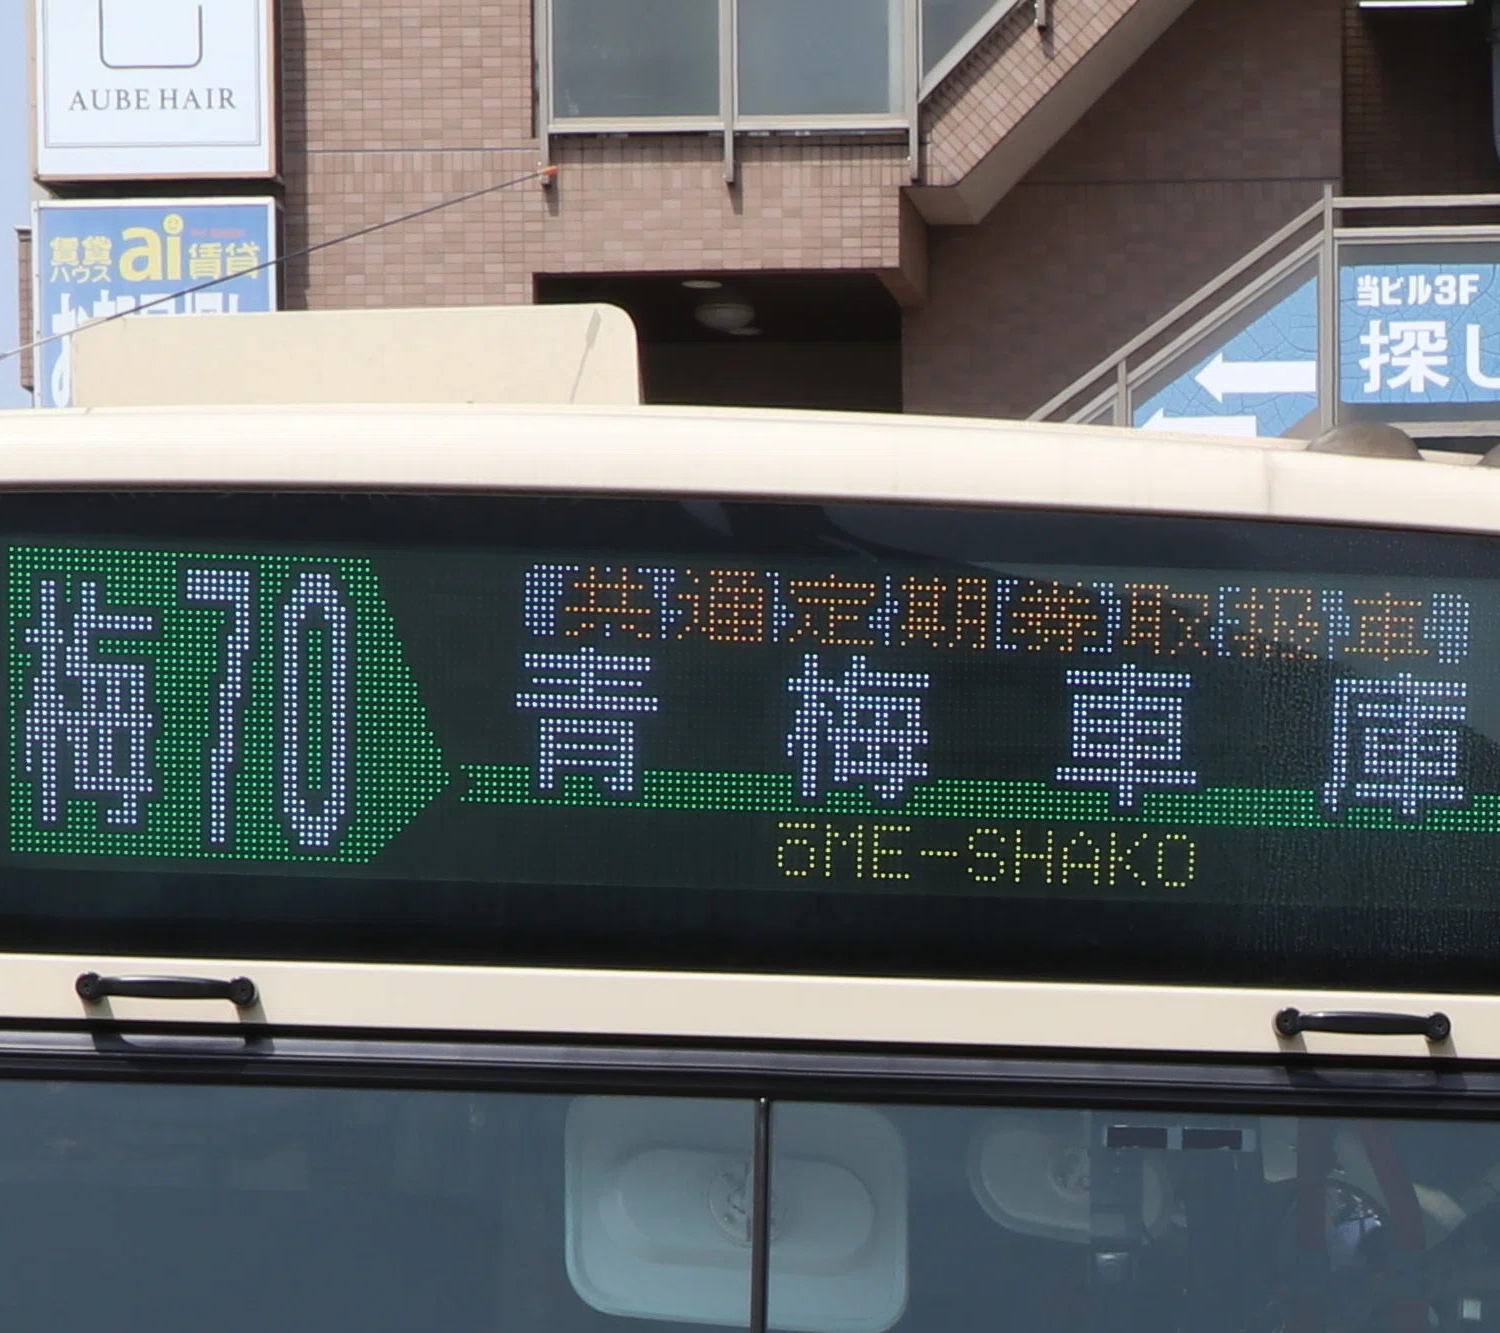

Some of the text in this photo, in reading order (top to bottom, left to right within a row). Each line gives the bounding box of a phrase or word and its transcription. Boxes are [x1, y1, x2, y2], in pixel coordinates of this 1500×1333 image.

[69, 87, 237, 111] AUBE HAIR
[50, 265, 112, 284] ハウス
[1356, 274, 1480, 307] 当ビル3F
[514, 645, 1468, 815] 青梅車庫
